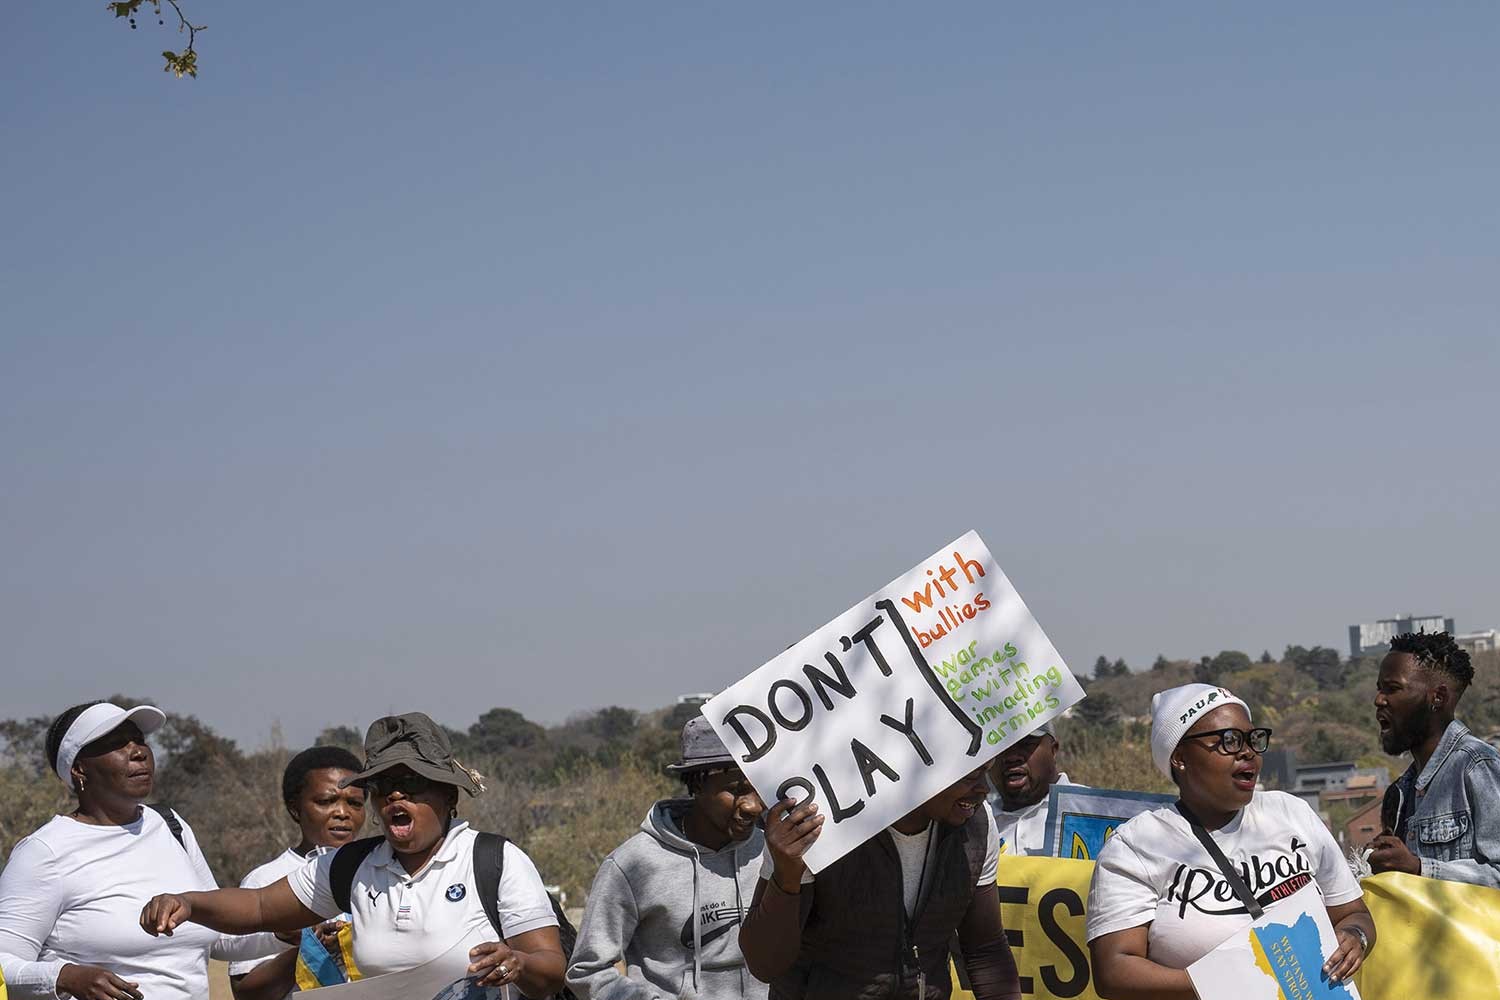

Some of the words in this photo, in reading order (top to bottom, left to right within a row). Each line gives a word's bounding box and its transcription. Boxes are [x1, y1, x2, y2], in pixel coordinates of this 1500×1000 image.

[901, 552, 986, 613] with
[911, 592, 991, 649] bullies
[722, 615, 893, 762] DON'T
[933, 640, 978, 679] war
[946, 642, 1018, 703] games
[970, 660, 1030, 702] with
[972, 665, 1063, 726] invading
[985, 692, 1061, 746] armies
